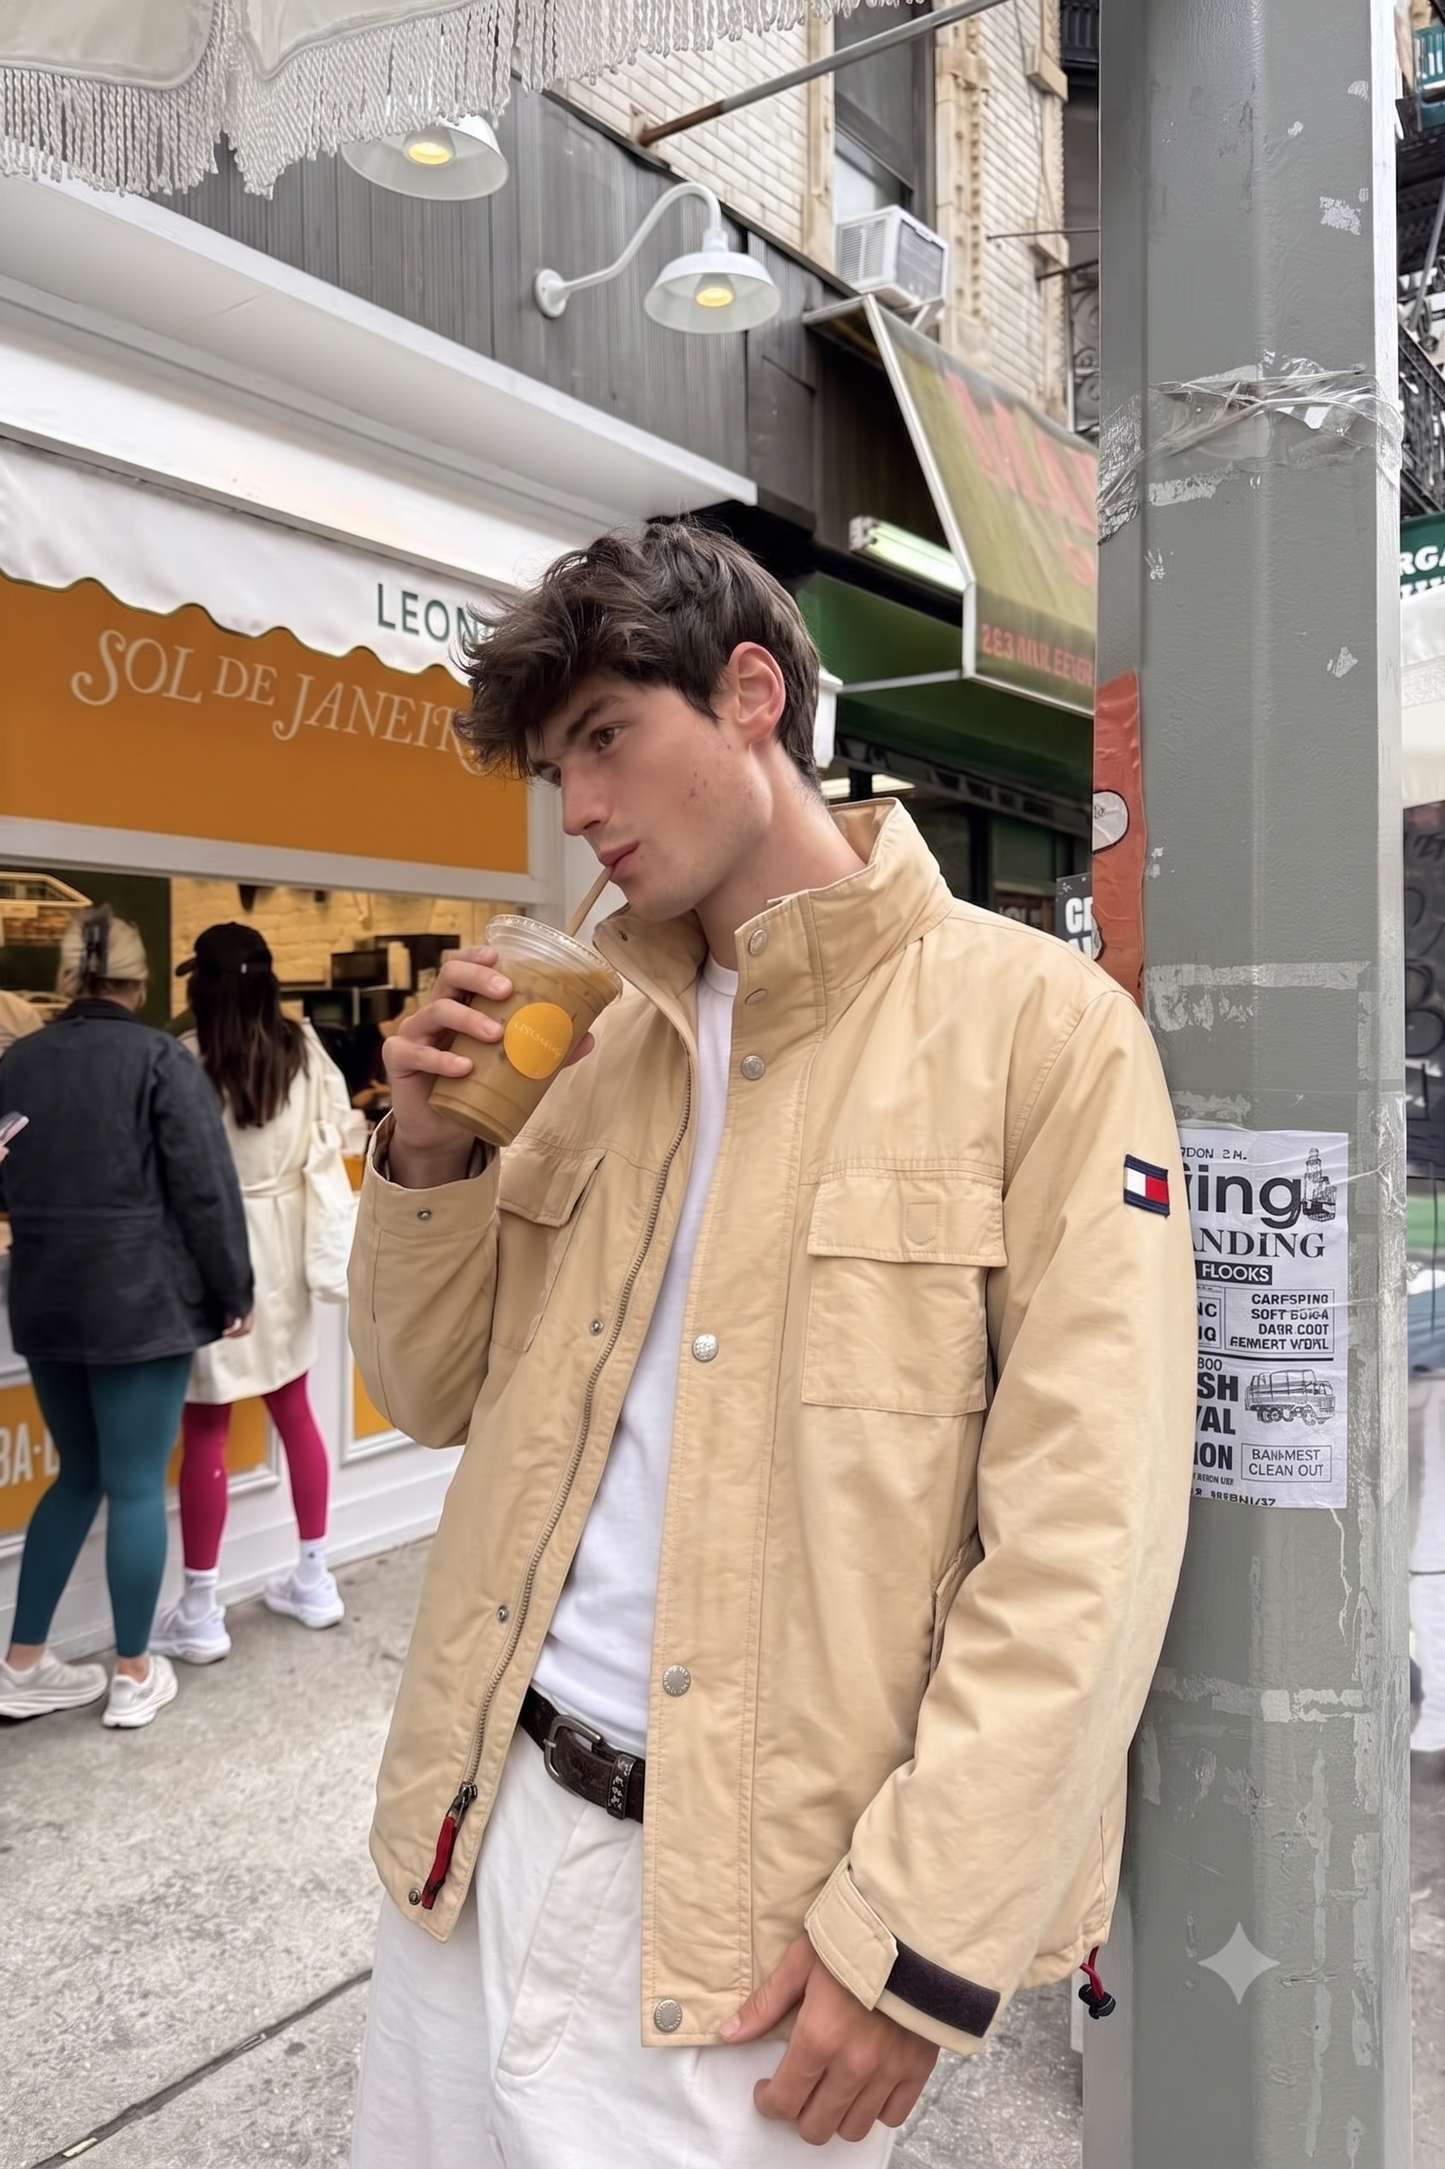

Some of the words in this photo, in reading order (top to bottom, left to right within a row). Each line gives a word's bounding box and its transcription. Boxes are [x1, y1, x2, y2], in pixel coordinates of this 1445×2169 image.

[1400, 544, 1445, 576] RG
[376, 582, 489, 649] LEON
[70, 629, 203, 706] SOL
[212, 654, 278, 706] DE
[1193, 1227, 1326, 1259] NDING
[1202, 1263, 1270, 1282] FLOOKS
[1251, 1308, 1287, 1320] SOFT
[1297, 1324, 1330, 1335] COOT
[1197, 1372, 1239, 1402] SH
[1196, 1405, 1236, 1435] AL
[1249, 1463, 1294, 1476] CLEAN
[1298, 1464, 1324, 1477] OUT
